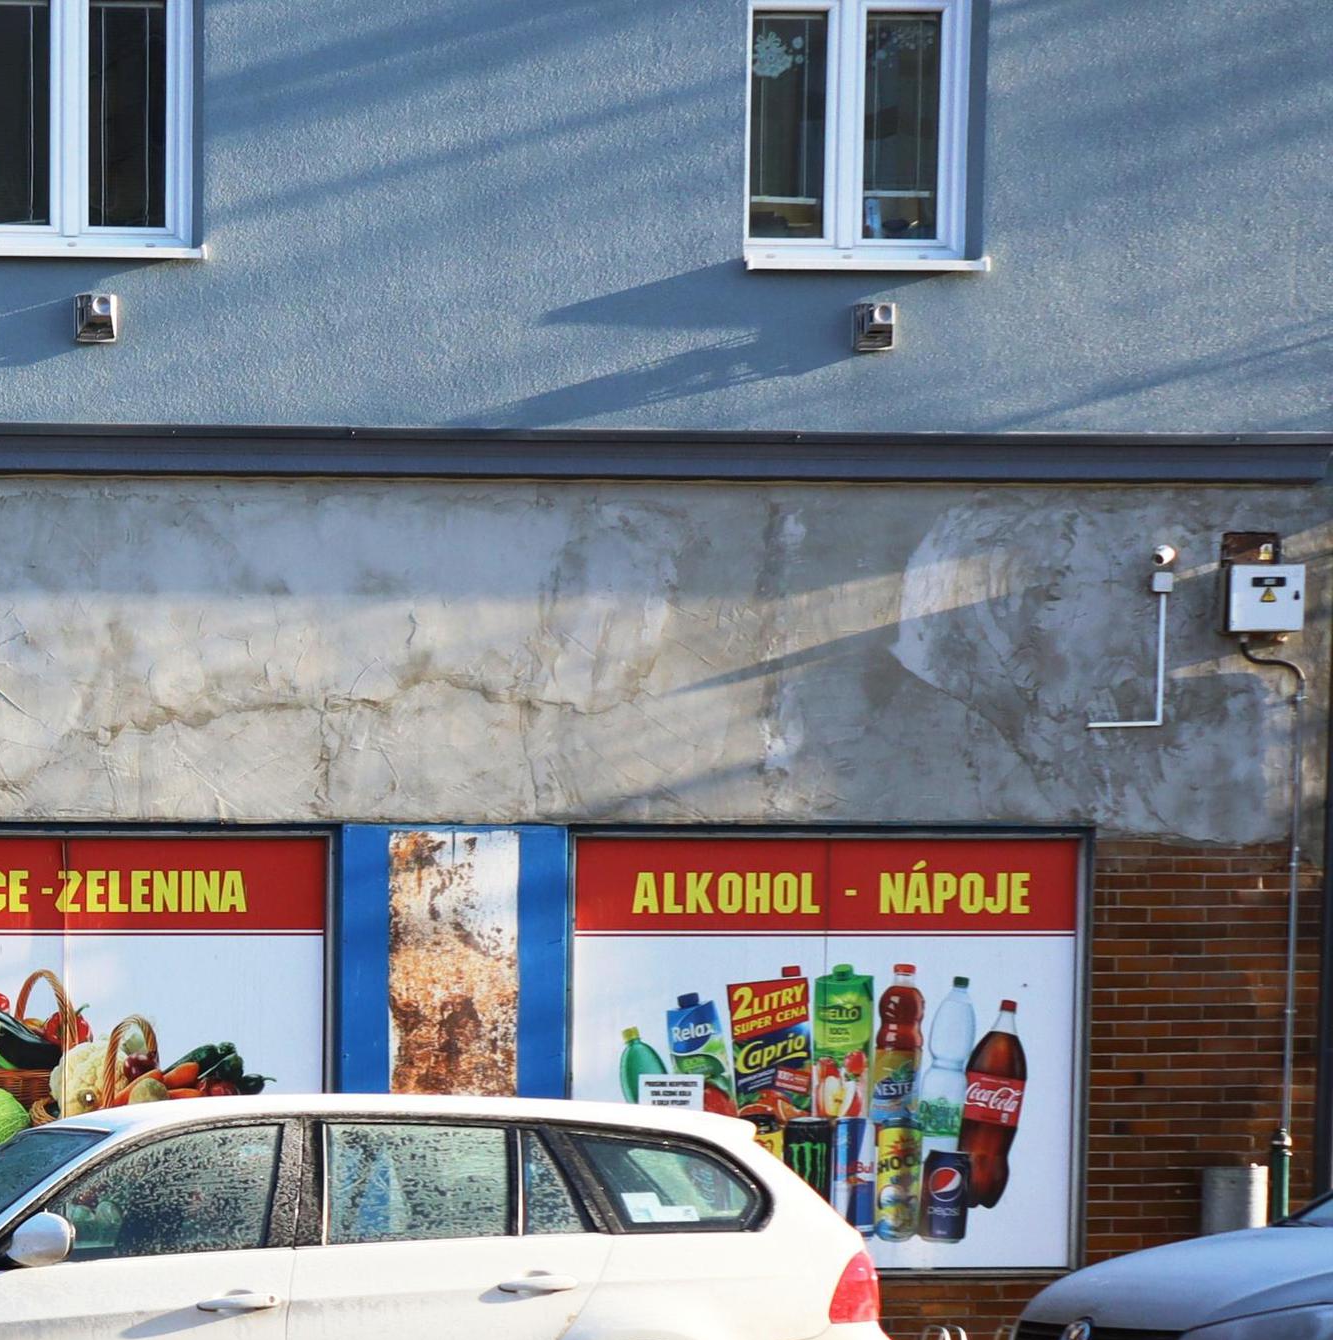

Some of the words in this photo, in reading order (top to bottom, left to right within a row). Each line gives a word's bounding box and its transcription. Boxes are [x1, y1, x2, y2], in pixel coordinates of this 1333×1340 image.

[632, 870, 821, 914] ALKOHOL
[879, 860, 1031, 914] NÁPOJE
[671, 1022, 716, 1041] Relax
[733, 1016, 772, 1036] SUPER
[775, 1006, 807, 1023] CENA
[735, 1033, 807, 1075] Caprio
[927, 1206, 959, 1218] pepsi
